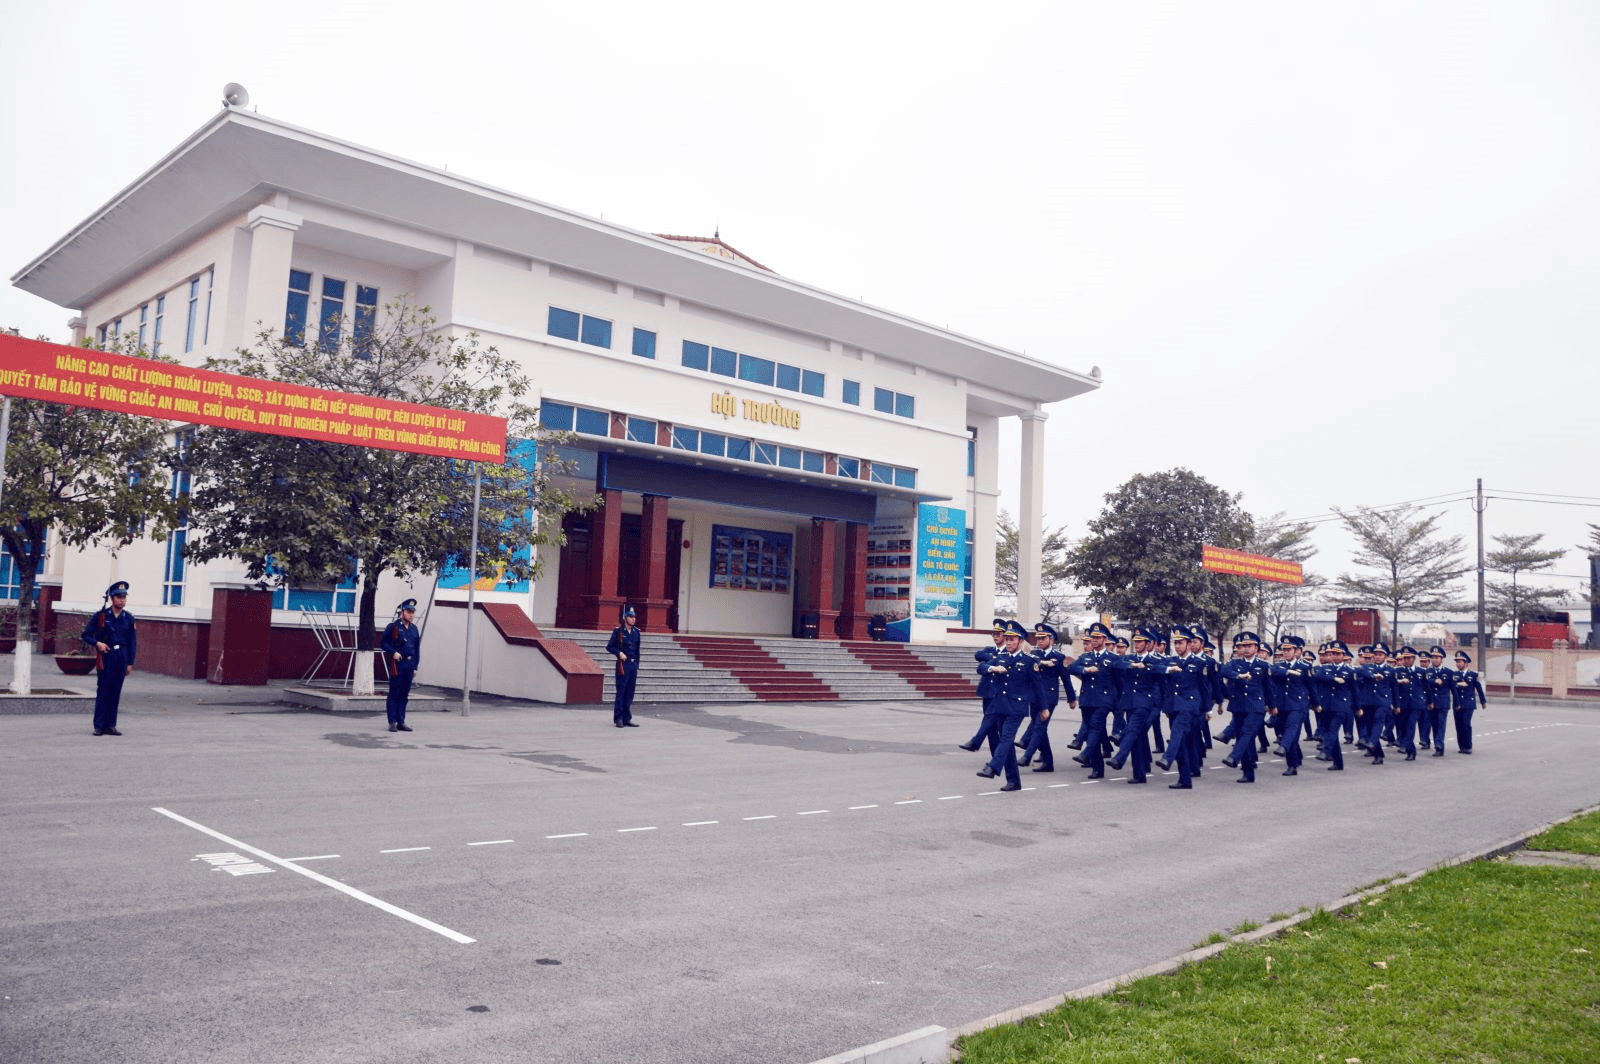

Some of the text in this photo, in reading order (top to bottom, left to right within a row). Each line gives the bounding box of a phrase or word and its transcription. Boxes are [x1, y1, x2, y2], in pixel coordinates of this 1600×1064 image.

[33, 373, 58, 392] TÂM
[59, 376, 82, 395] BẢO
[84, 381, 98, 401] VỆ
[100, 384, 128, 403] VỮNG
[129, 387, 156, 407] CHẮC
[157, 395, 173, 410] AN
[174, 397, 201, 415] NINH,
[202, 400, 223, 418] CHỦ
[258, 410, 277, 426] DUY
[278, 412, 293, 428] TRÌ
[294, 416, 328, 433] NGHIÊM
[328, 420, 352, 436] PHÁP
[352, 423, 373, 441] LUẬT
[374, 426, 396, 442] TRÊN
[396, 428, 417, 445] VÙNG
[418, 430, 437, 447] BIỂN
[438, 436, 458, 452] ĐƯỢC
[459, 438, 480, 453] PHÂN
[480, 441, 501, 456] CÔNG
[55, 354, 87, 373] NÂNG
[88, 360, 110, 377] CAO
[112, 363, 138, 381] CHẤT
[140, 370, 172, 388] LƯỢNG
[174, 374, 201, 392] HUẤN
[203, 380, 235, 399] LUYỆN,
[265, 390, 283, 406] XÂY
[284, 393, 309, 410] DỰNG
[330, 398, 348, 415] NẾP
[348, 402, 374, 419] CHÍNH
[393, 409, 410, 424] RÈN
[411, 413, 435, 430] LUYỆN
[448, 417, 467, 434] LUẬT
[711, 389, 801, 431] HỘI TRƯỜNG
